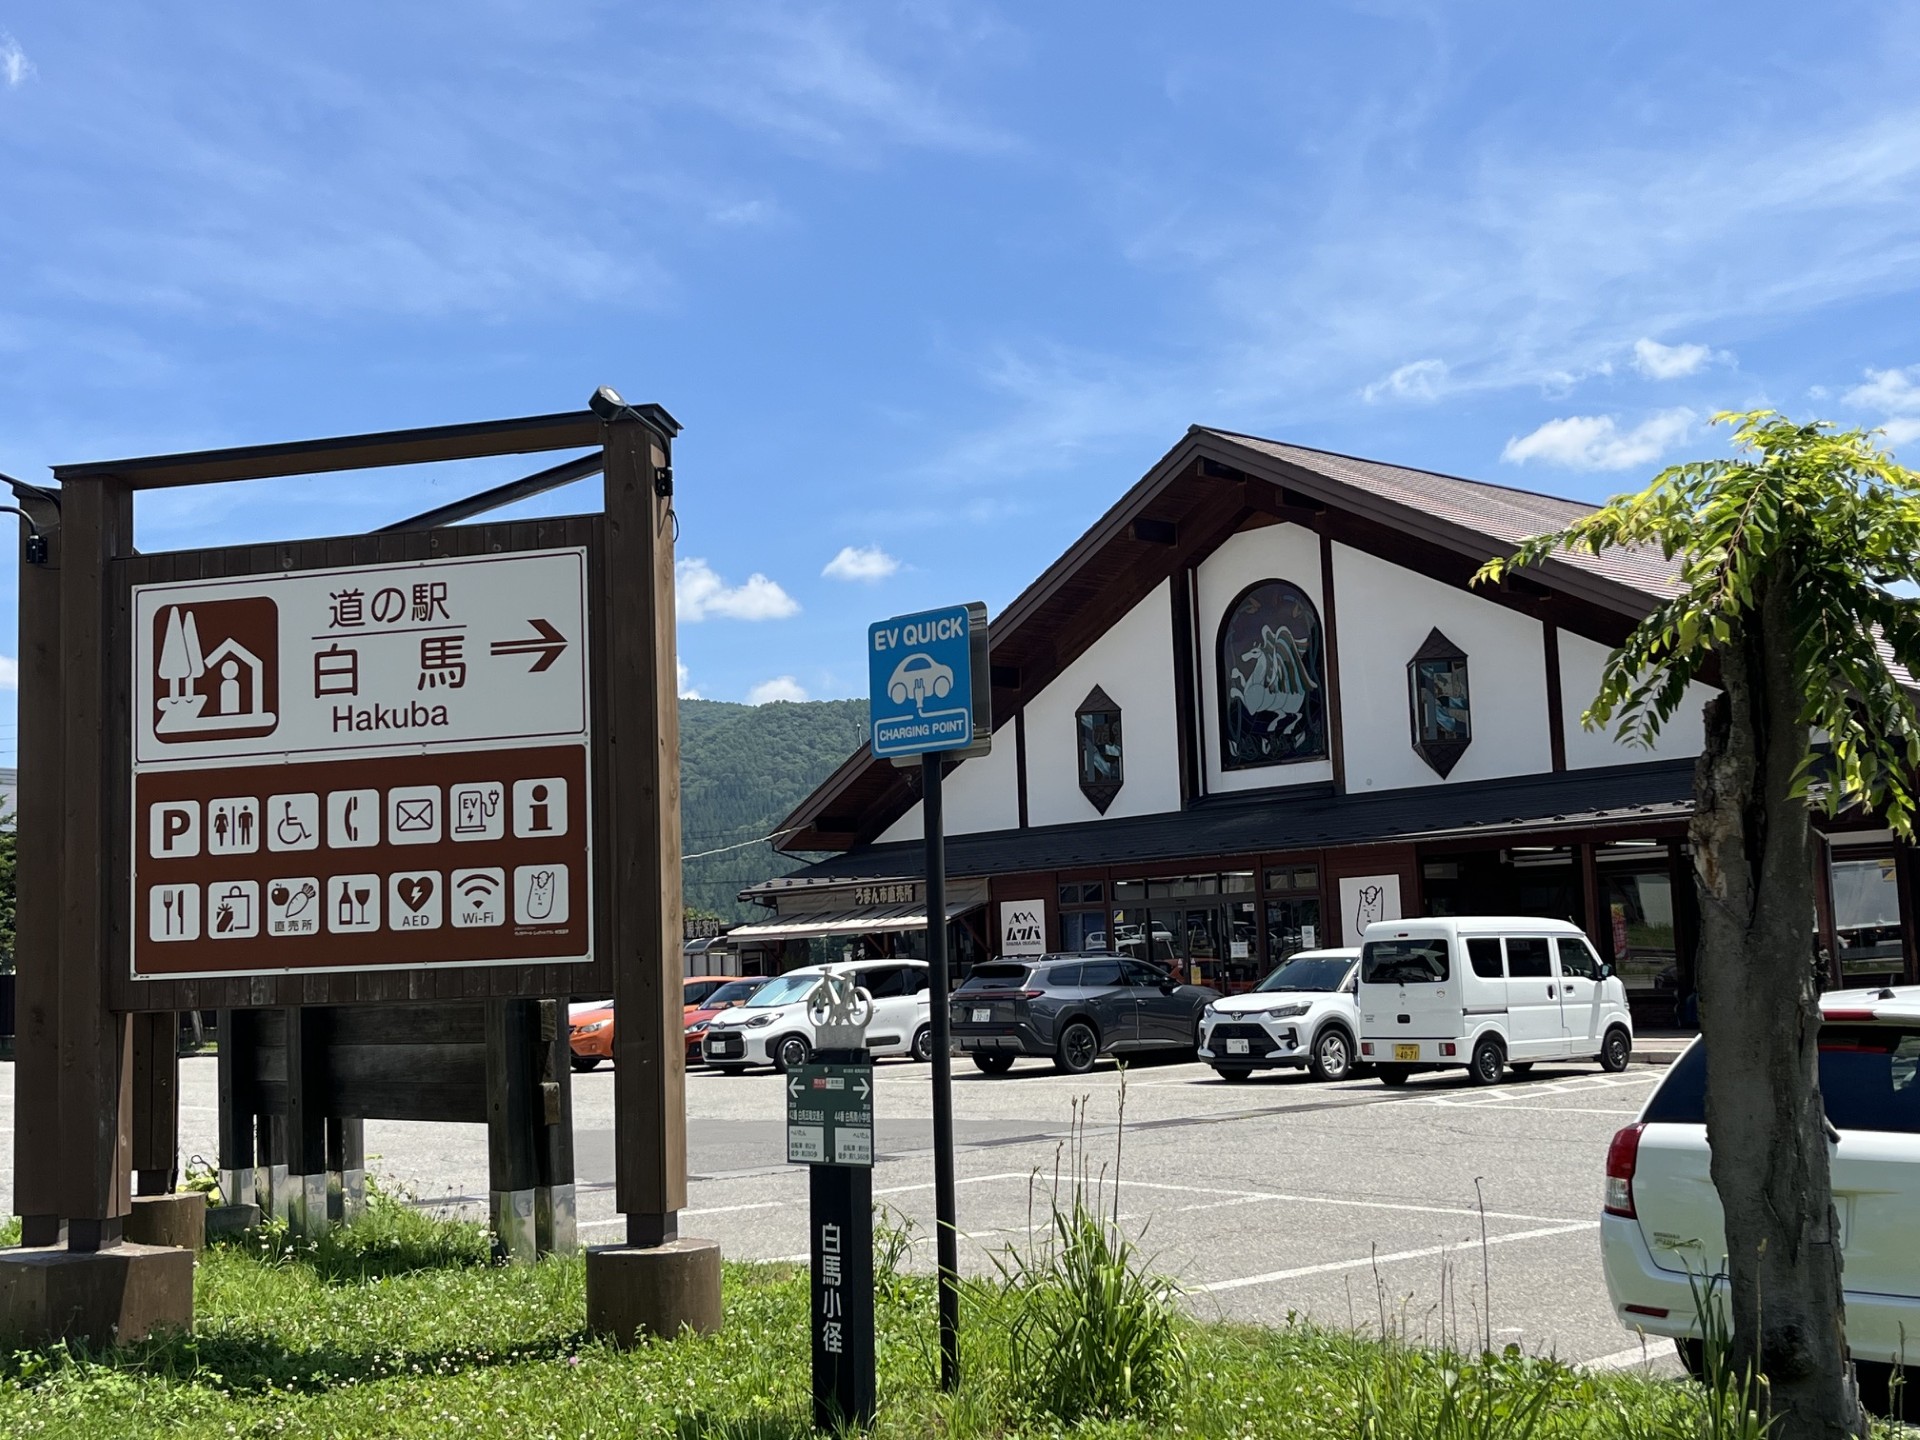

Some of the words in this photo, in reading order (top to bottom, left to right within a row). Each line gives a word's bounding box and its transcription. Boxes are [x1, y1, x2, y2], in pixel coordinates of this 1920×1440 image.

[329, 582, 450, 629] 道の駅
[874, 627, 899, 651] EV
[903, 616, 964, 647] QUICK
[314, 635, 467, 699] 白馬
[333, 701, 449, 732] Hakuba
[879, 723, 930, 742] CHARGING
[932, 719, 964, 735] POINT
[463, 797, 478, 809] EV
[855, 884, 914, 905] ろまん市直売所
[274, 919, 313, 932] 直売所
[402, 914, 430, 927] AED
[462, 911, 494, 924] Wi-Fi
[822, 1223, 843, 1354] 白馬小径
